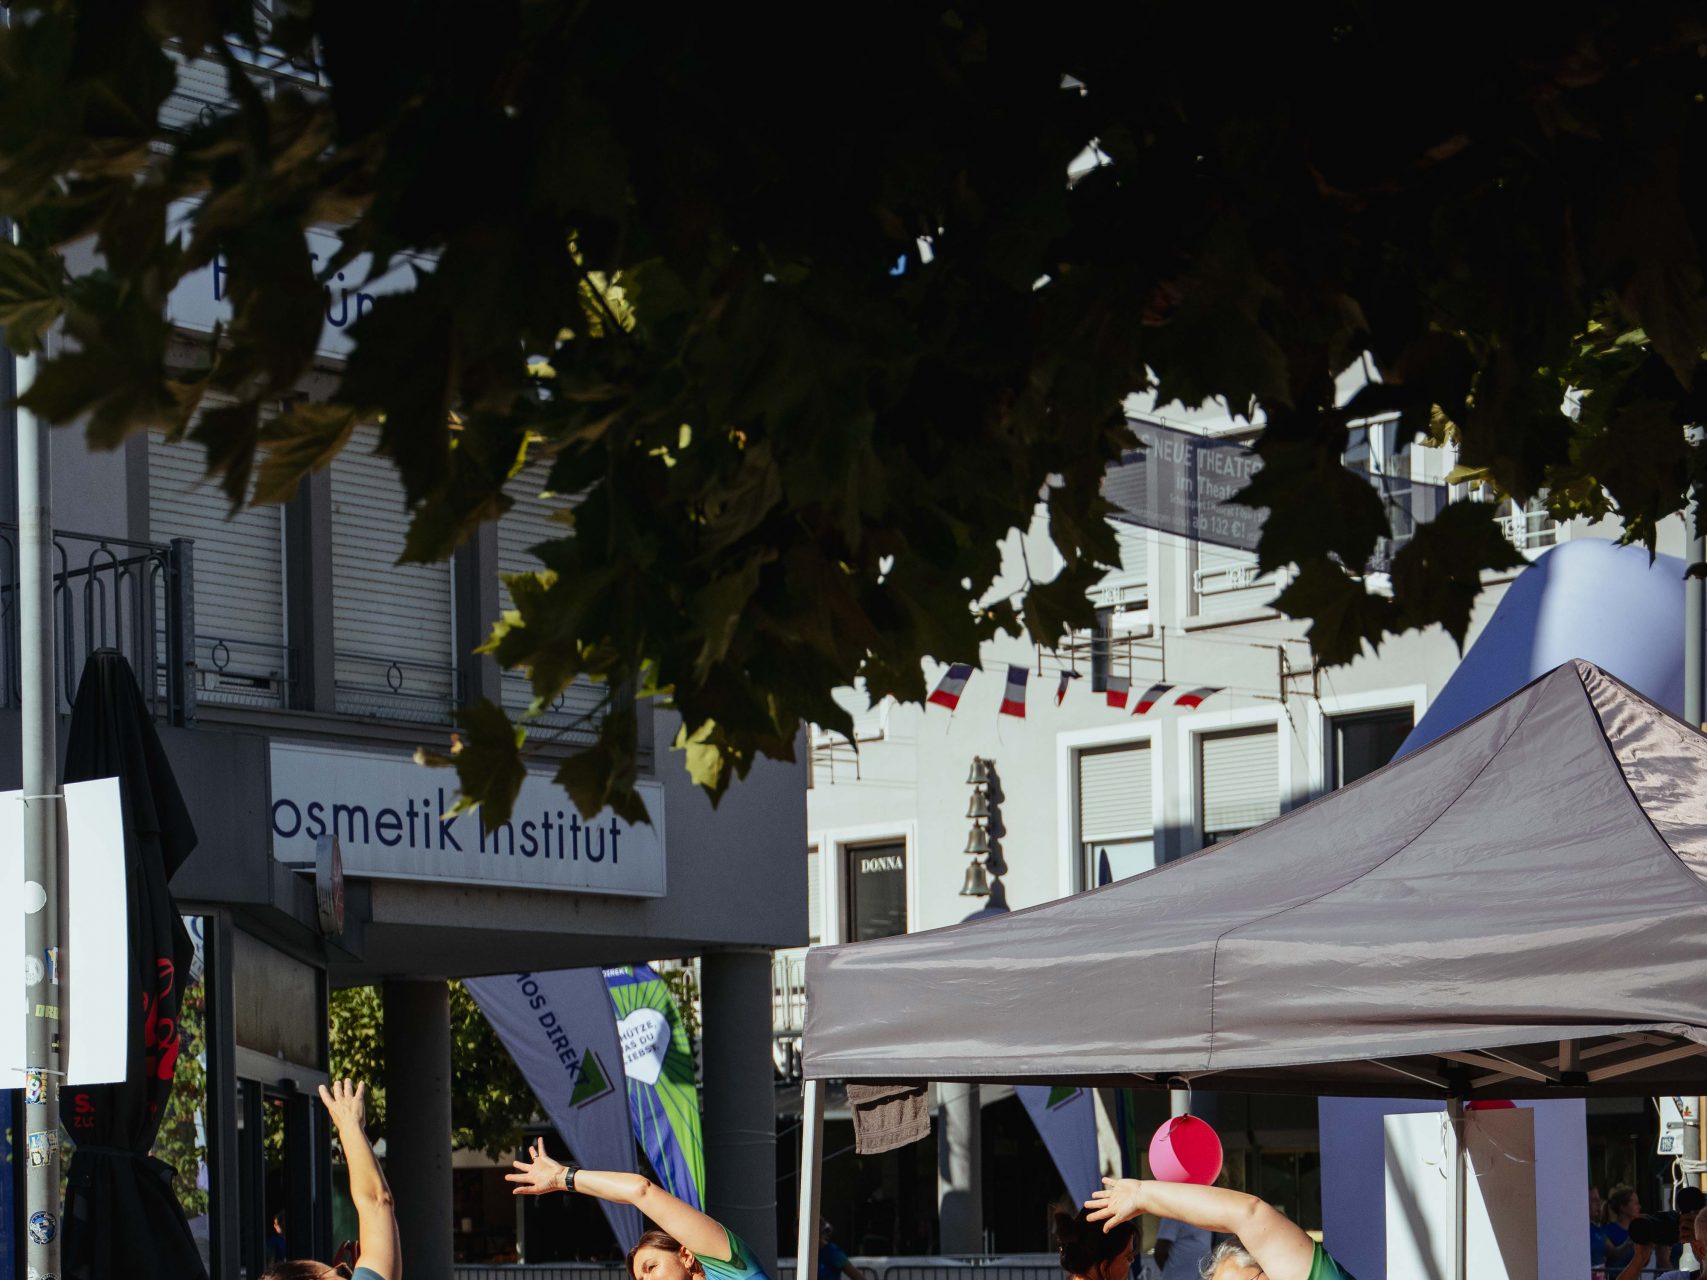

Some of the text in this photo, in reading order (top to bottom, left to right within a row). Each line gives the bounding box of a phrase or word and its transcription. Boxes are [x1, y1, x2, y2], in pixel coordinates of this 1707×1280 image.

[1153, 439, 1193, 467] NEUE
[1176, 472, 1193, 492] im
[1192, 514, 1208, 530] ab
[1211, 516, 1229, 536] 132
[271, 787, 621, 864] osmetik Institut
[861, 855, 904, 874] DONNA
[538, 1011, 591, 1087] DIREKT
[640, 1032, 654, 1045] DU
